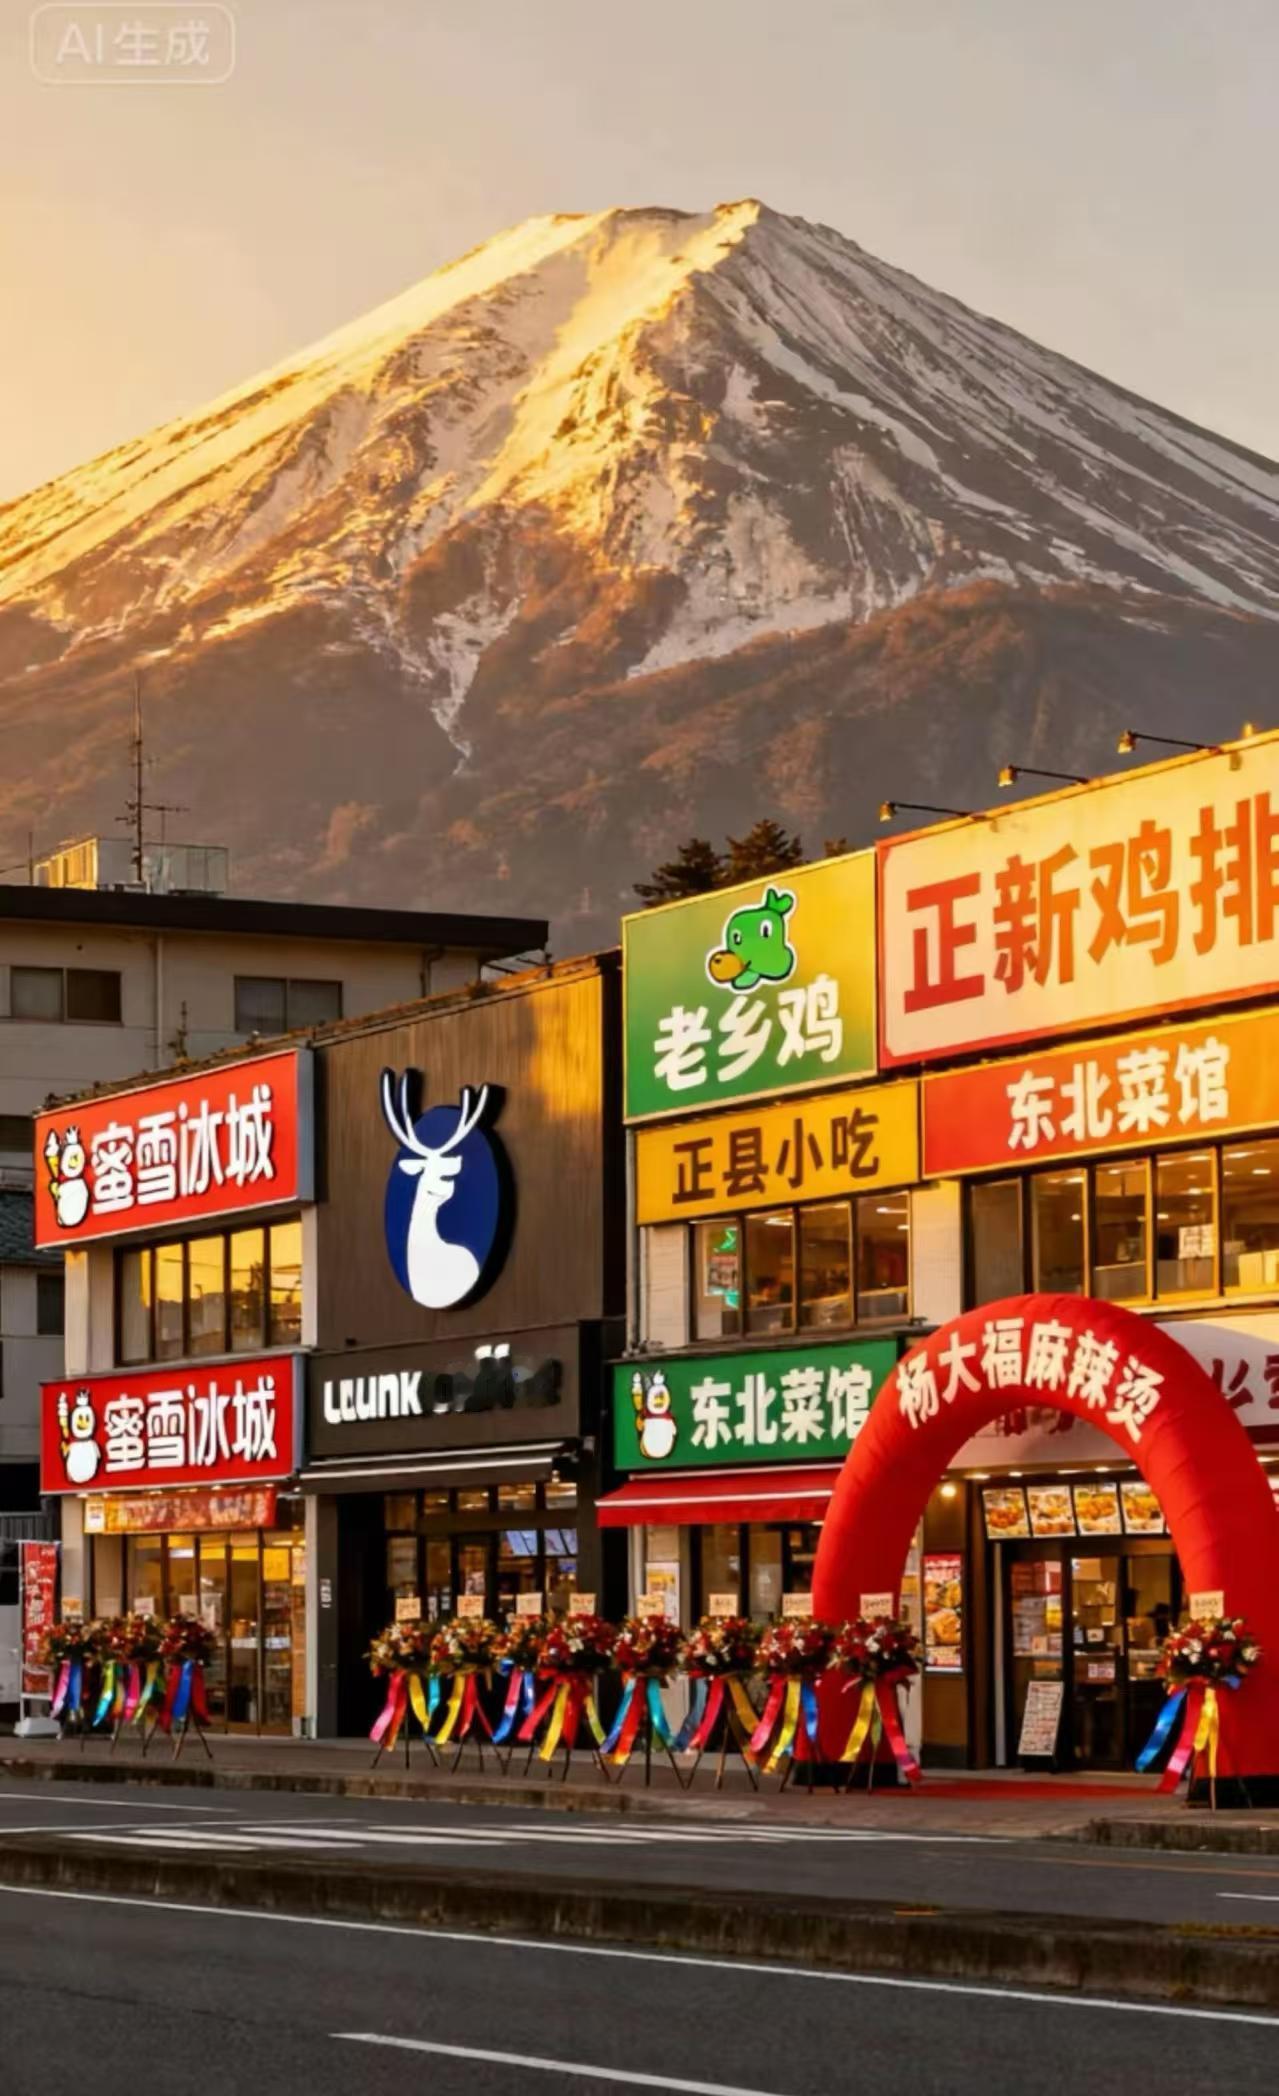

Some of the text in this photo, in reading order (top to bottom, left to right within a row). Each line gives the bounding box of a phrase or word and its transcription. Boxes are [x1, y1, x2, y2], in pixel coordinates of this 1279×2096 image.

[904, 791, 1279, 1015] 正新鸡排
[653, 973, 843, 1092] 老乡鸡
[91, 1083, 275, 1216] 蜜雪冰城
[1006, 1035, 1231, 1151] 东北菜馆
[672, 1107, 880, 1204] 正县小吃
[104, 1375, 278, 1473] 蜜雪冰城
[690, 1362, 873, 1450] 东北菜馆
[896, 1317, 1165, 1444] 杨大福麻辣烫
